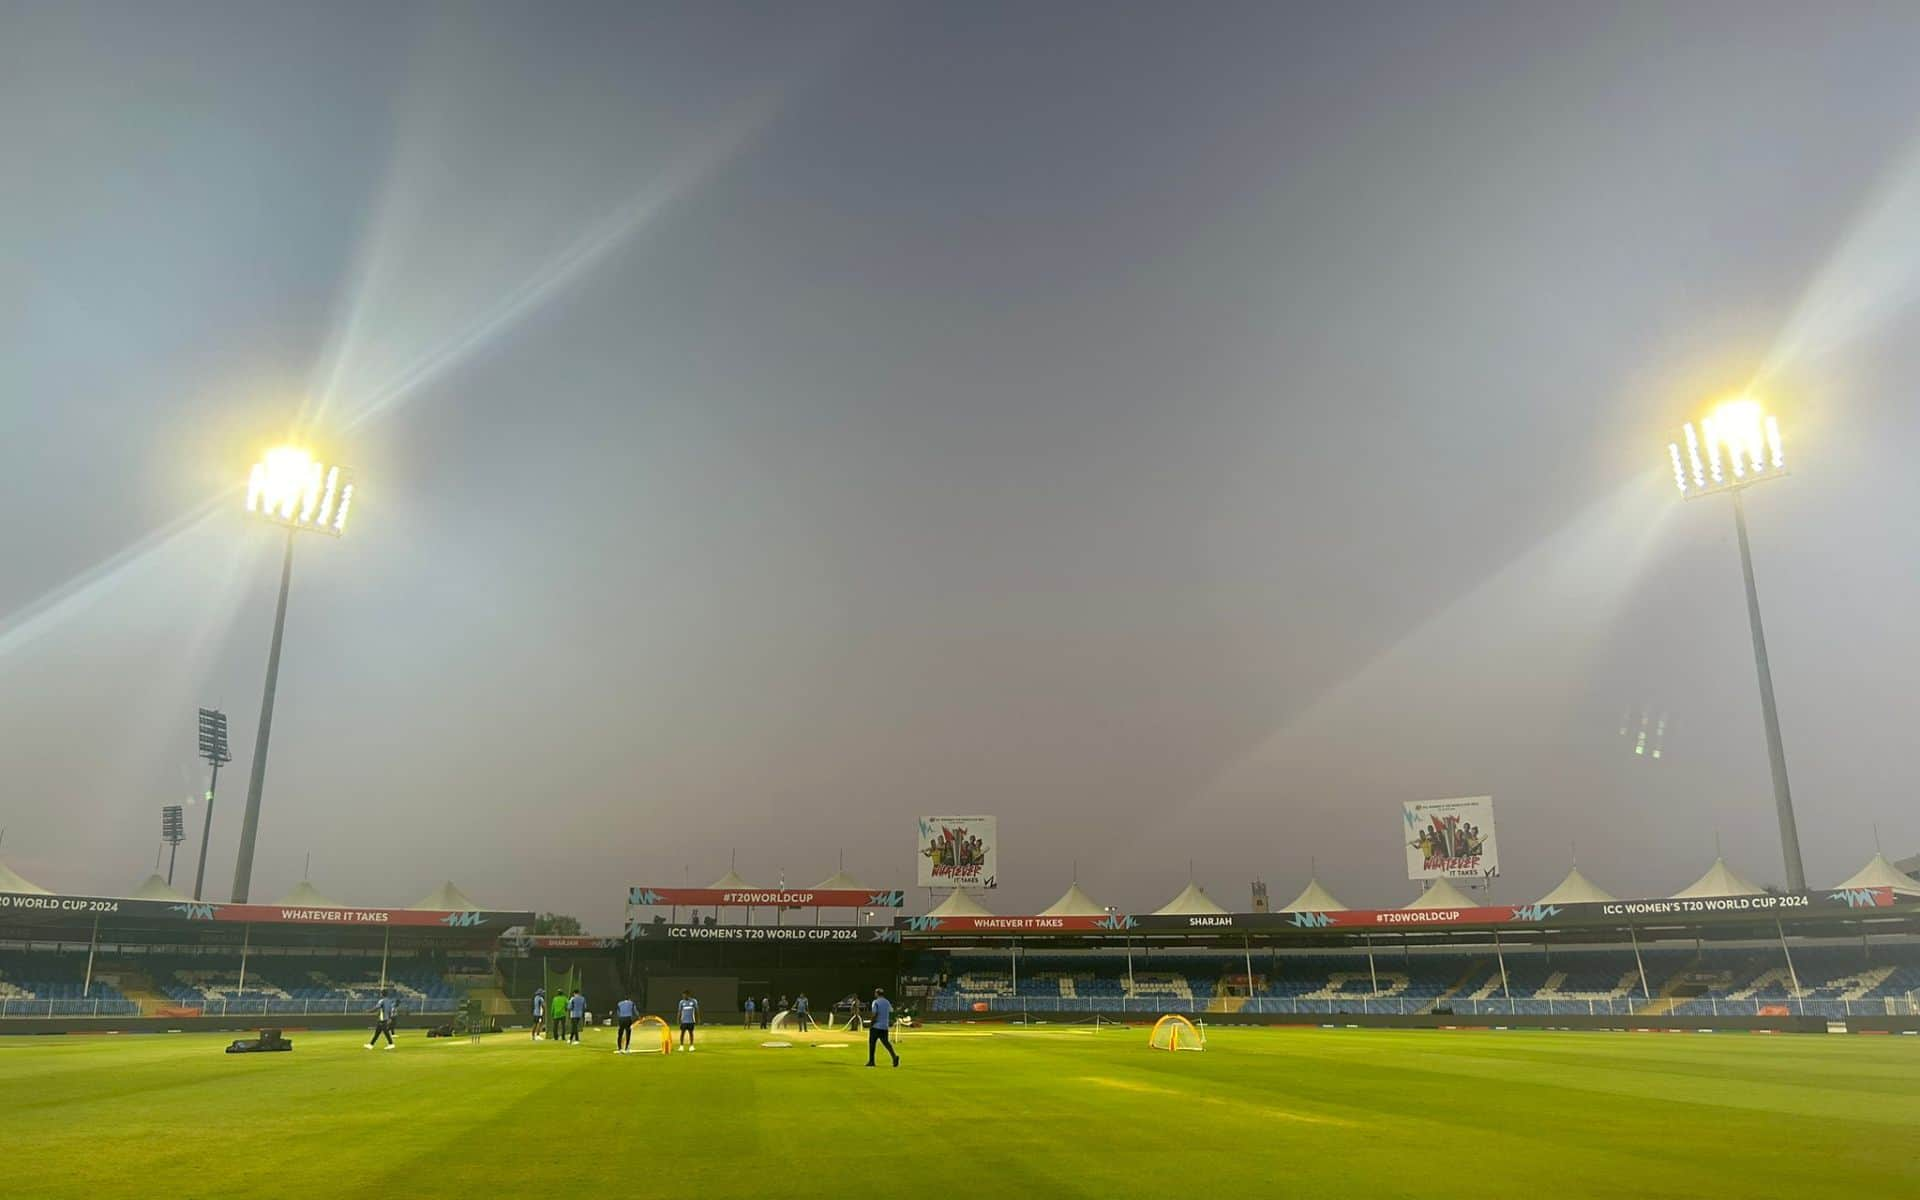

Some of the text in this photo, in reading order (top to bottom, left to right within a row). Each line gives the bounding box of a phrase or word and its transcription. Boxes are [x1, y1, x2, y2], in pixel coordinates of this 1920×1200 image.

[723, 893, 814, 903] #T20WORLDCUP
[0, 897, 119, 912] 0 WORLD CUP 2024
[1604, 896, 1809, 914] ICC WOMEN'S T20 WORLD CUP 2024
[282, 910, 389, 922] WHATEVER IT TAKES
[1189, 917, 1233, 926] SHARJAH
[1377, 911, 1460, 922] #T20WORLDCUP
[974, 919, 1064, 928] WHATEVER IT TAKES
[668, 928, 858, 939] ICC WOMEN'S T20 WORLD CUP 2024
